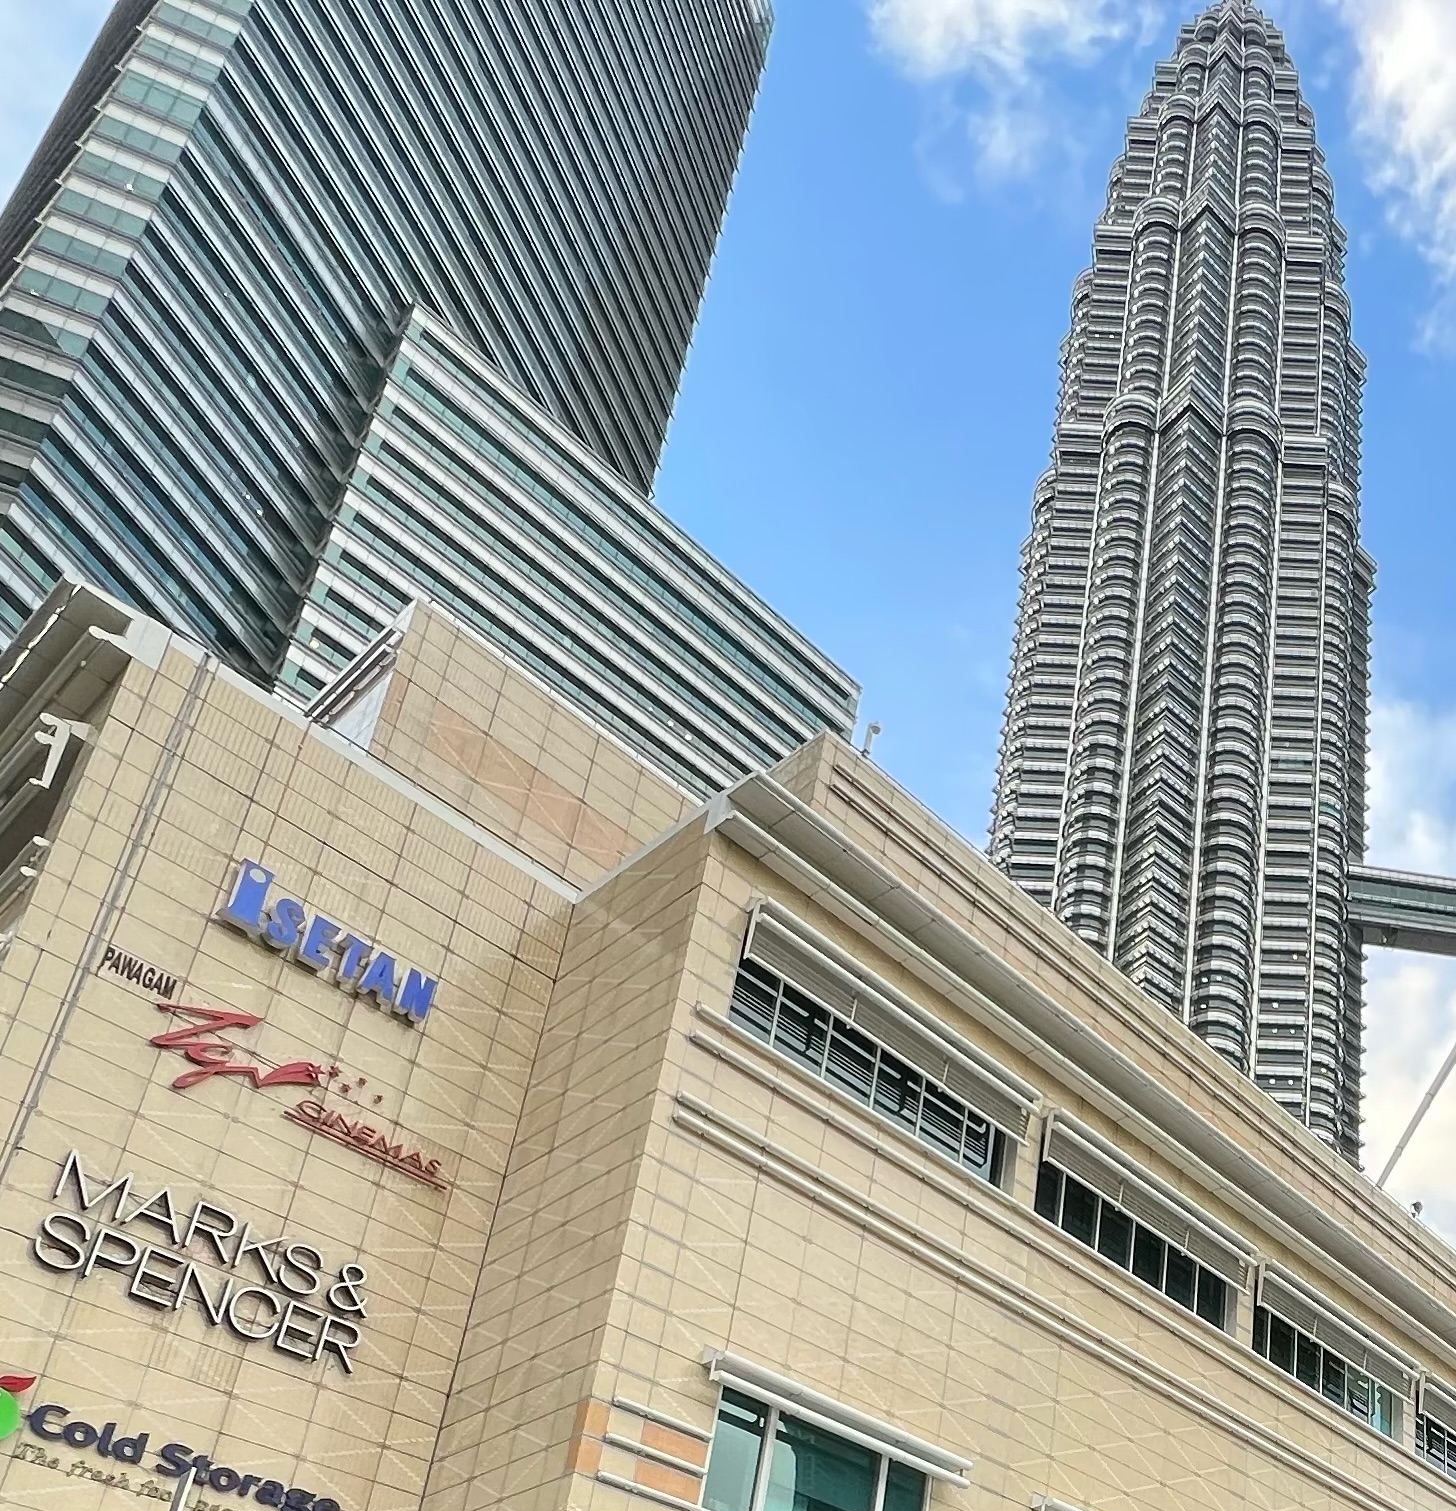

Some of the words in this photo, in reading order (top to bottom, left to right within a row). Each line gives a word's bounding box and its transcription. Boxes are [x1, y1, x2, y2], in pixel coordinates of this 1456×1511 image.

[101, 947, 177, 999] PAWAGAM
[216, 856, 440, 1026] ISETAN
[295, 1099, 444, 1177] CINEMAS
[53, 1148, 324, 1297] MARKS
[326, 1262, 369, 1319] &
[34, 1211, 364, 1374] SPENCER
[13, 1442, 60, 1470] The
[136, 1479, 173, 1503] foo
[27, 1404, 150, 1465] Cold
